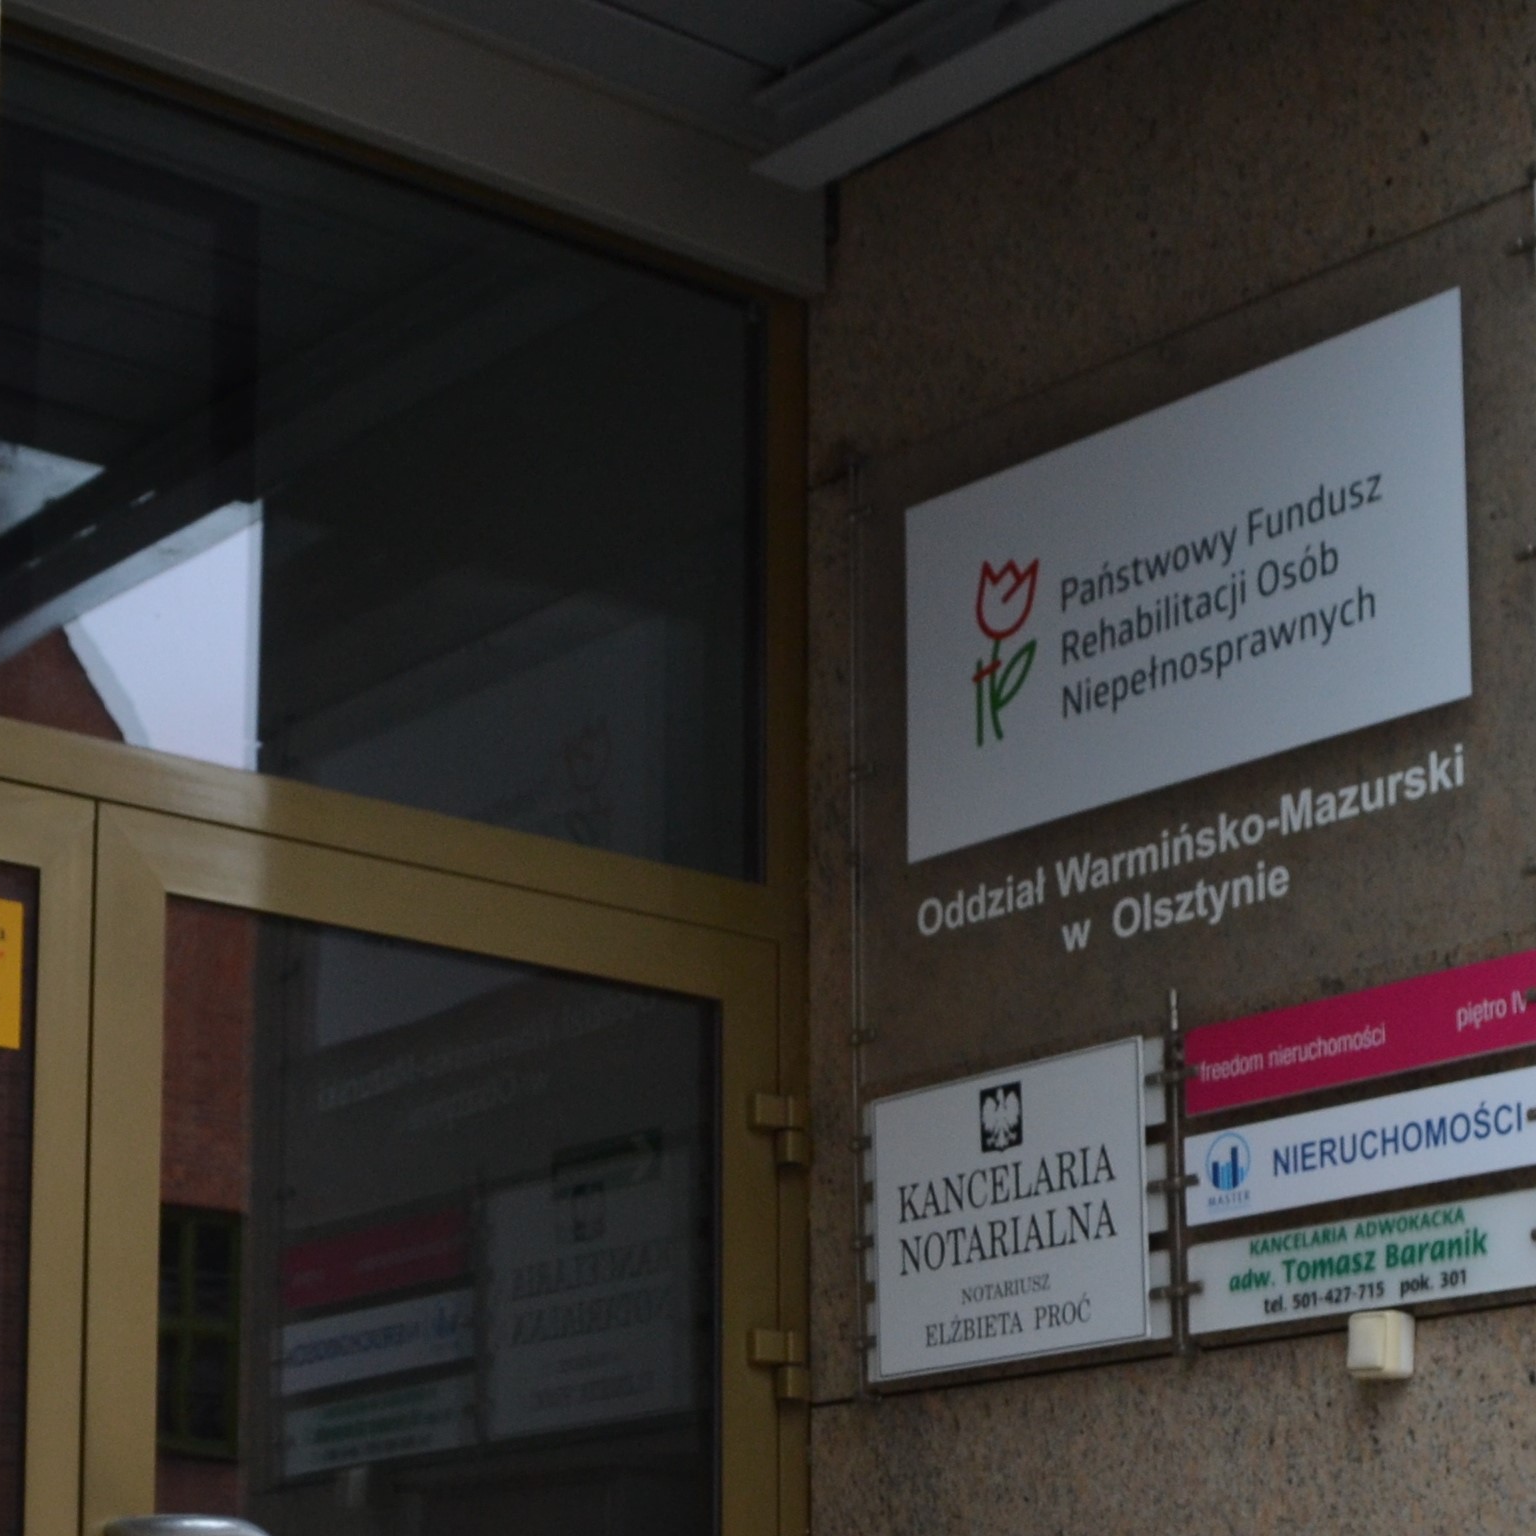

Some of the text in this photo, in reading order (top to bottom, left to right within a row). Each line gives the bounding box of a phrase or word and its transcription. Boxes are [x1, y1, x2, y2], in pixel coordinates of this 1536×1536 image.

[1061, 473, 1383, 613] Państwowy Fundusz
[1061, 541, 1340, 666] Rehabilitacji Osób
[1062, 585, 1377, 720] Niepełnosprawnych
[916, 743, 1465, 937] Oddział Warmińsko-Mazurski
[1062, 861, 1291, 952] w Olsztynie
[1199, 1022, 1387, 1083] freedom nieruchomości
[1455, 998, 1507, 1034] piętro
[1272, 1101, 1524, 1178] NIERUCHOMOŚCI
[897, 1143, 1117, 1224] KANCELARIA
[899, 1198, 1118, 1277] NOTARIALNA
[1229, 1226, 1488, 1293] adw. Tomasz Baranik
[1249, 1206, 1466, 1256] KANCELARIA ADWOKACKA
[925, 1292, 1092, 1349] ELŻBIETA PROĆ
[961, 1273, 1052, 1305] NOTARIUSZ
[1263, 1269, 1468, 1315] tel. 501-427-715 pok. 301
